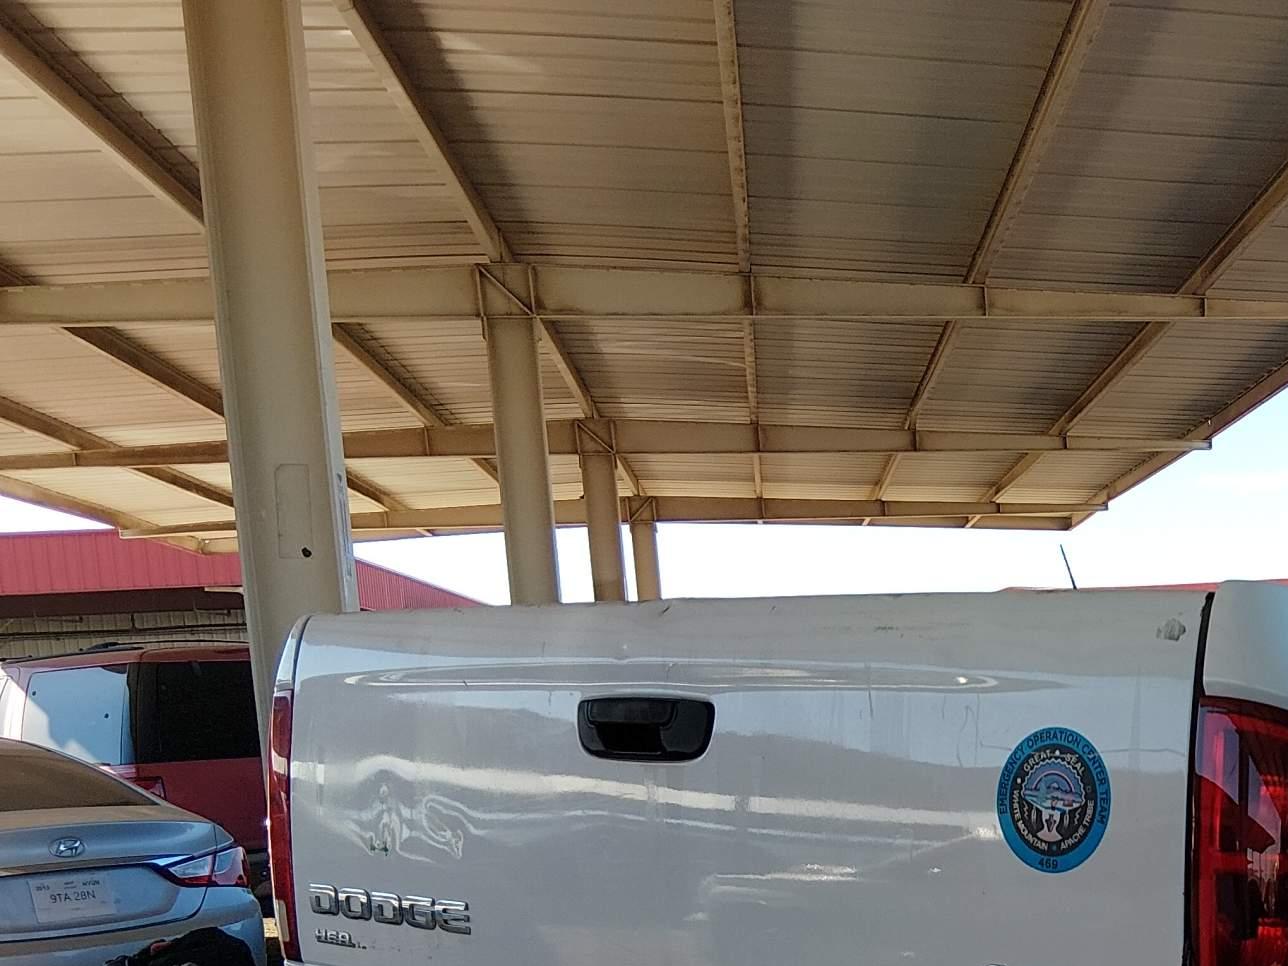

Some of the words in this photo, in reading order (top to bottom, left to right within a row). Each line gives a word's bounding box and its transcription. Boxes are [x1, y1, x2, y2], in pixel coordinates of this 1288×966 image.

[999, 744, 1024, 815] EMERGENCY
[1026, 730, 1082, 749] OPERATION
[1082, 743, 1106, 784] CENTER
[1097, 791, 1109, 825] TEAM
[1023, 749, 1051, 772] GREAT
[1064, 753, 1086, 775] SEAL
[1012, 790, 1021, 820] WHITE
[1018, 820, 1049, 850] MOUNTAIN
[1060, 823, 1087, 850] APACHE
[1084, 800, 1095, 825] TRIBE
[1038, 858, 1058, 870] 469
[308, 882, 472, 935] DODGE
